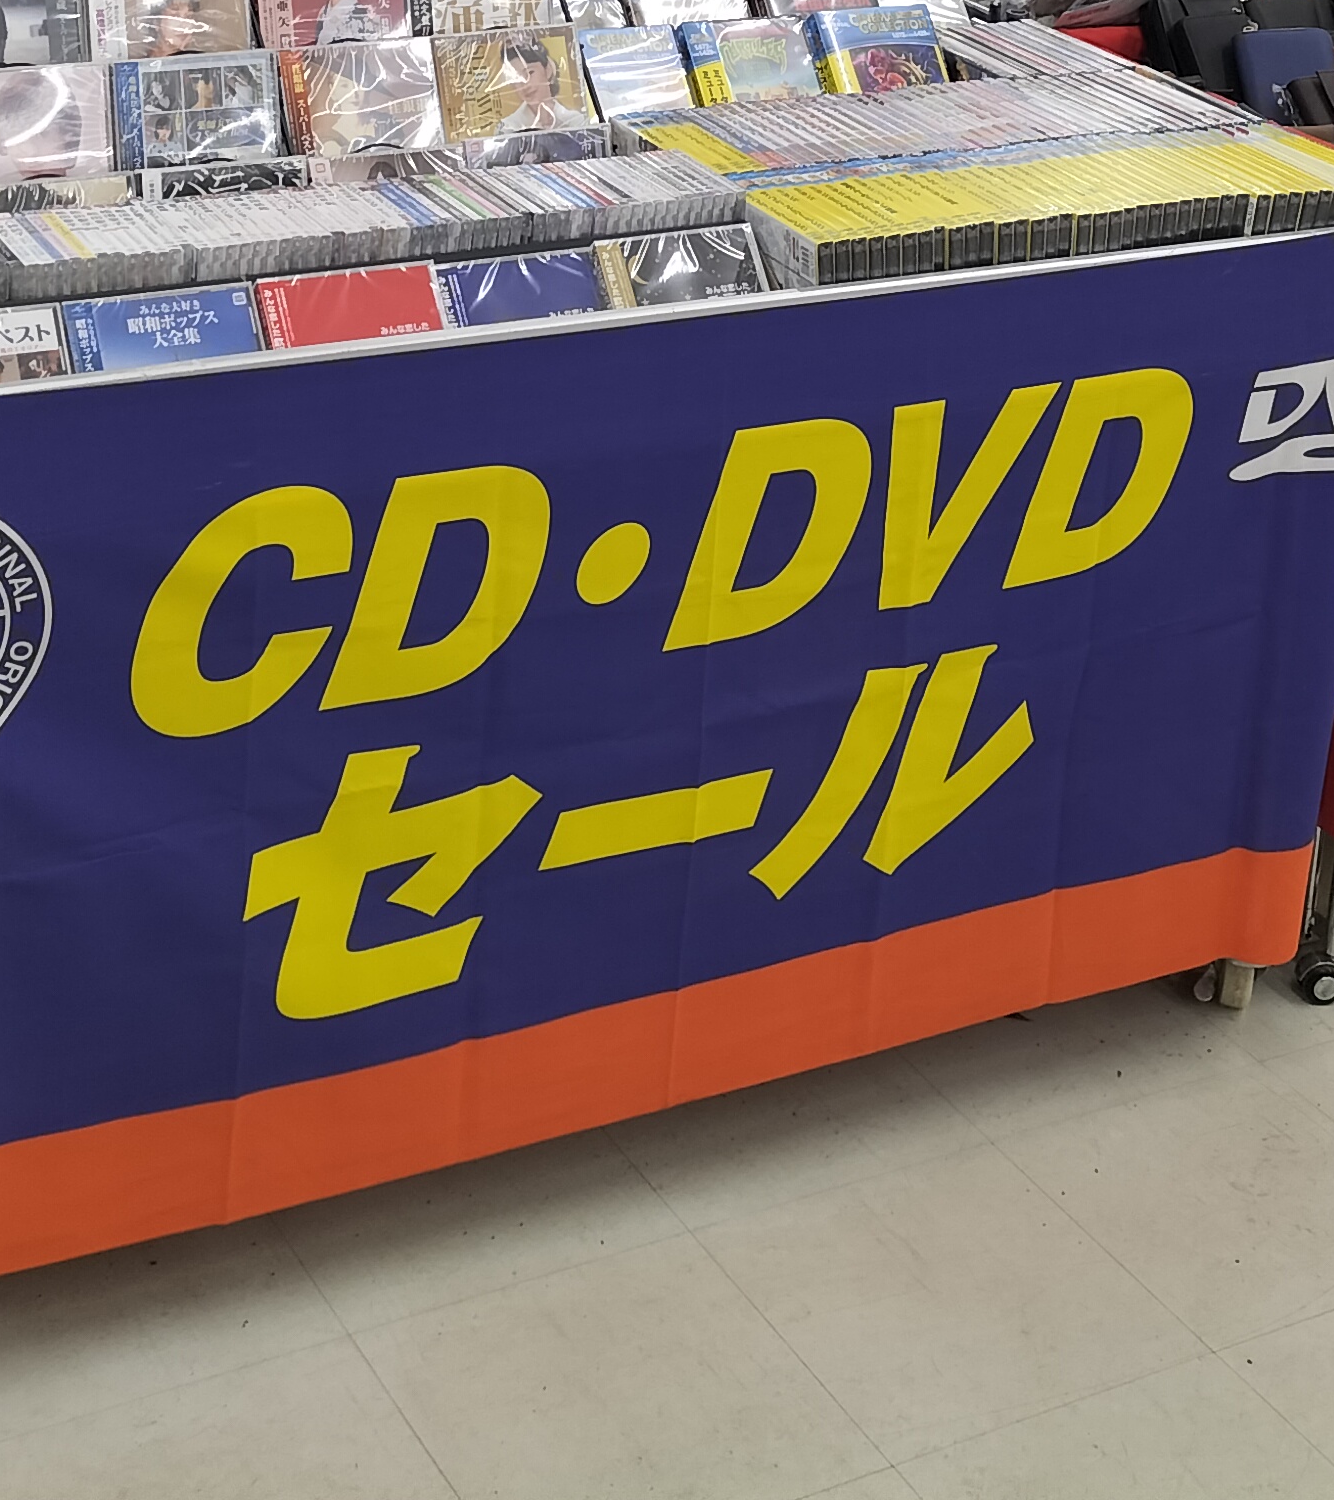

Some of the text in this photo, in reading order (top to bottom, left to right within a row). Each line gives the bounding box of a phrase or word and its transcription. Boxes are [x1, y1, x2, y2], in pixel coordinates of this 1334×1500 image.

[139, 301, 201, 315] みんな大好き
[127, 310, 219, 335] 昭和ポップス
[380, 321, 431, 335] みんな恋した
[152, 327, 201, 348] 大全集
[241, 642, 1037, 1020] セール
